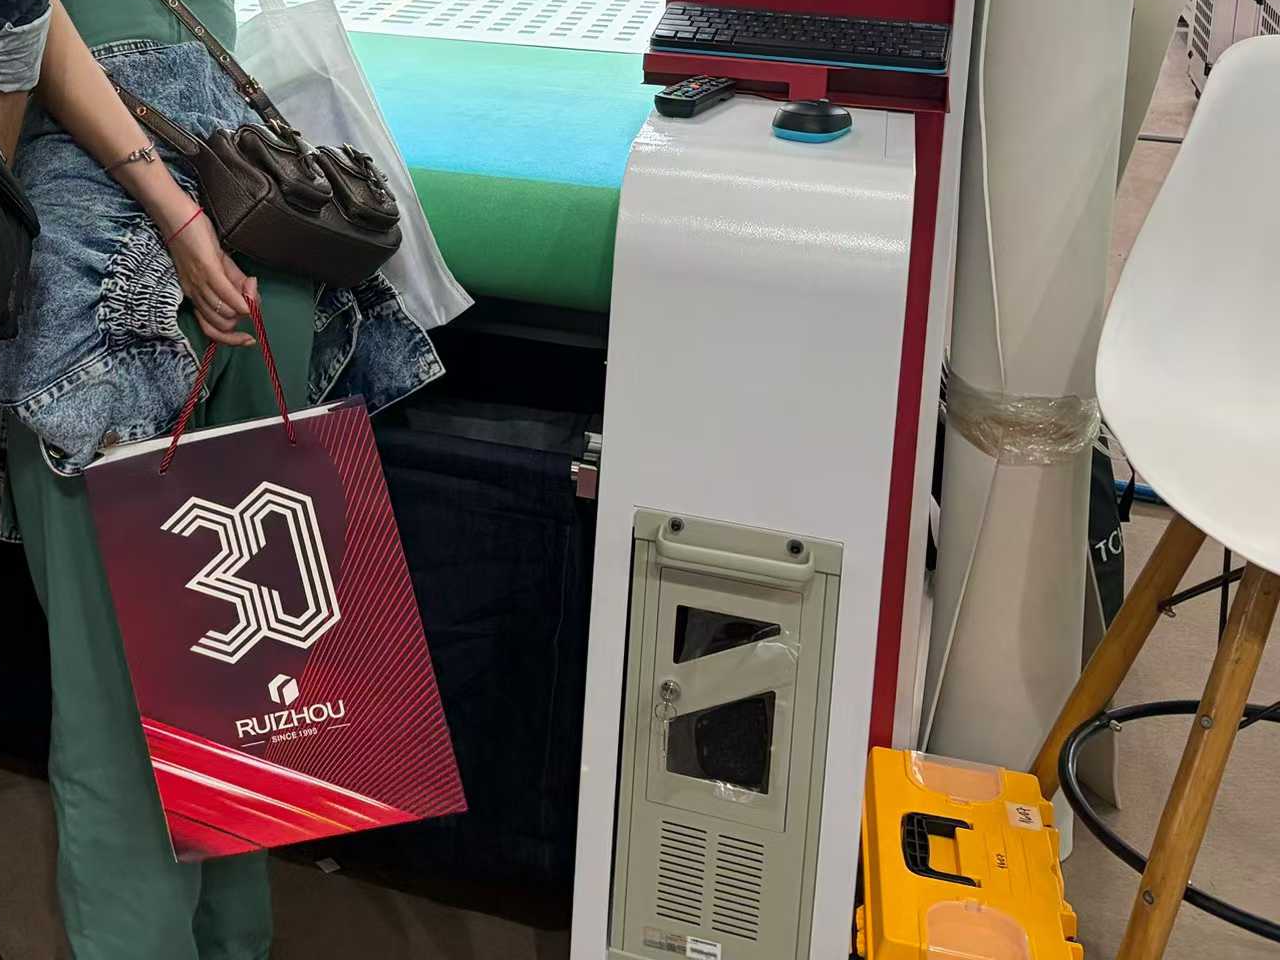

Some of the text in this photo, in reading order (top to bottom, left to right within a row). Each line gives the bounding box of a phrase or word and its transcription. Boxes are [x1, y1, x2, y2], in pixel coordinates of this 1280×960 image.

[160, 481, 341, 664] 30
[235, 699, 345, 738] RUIZHOU
[271, 731, 297, 743] SINCE
